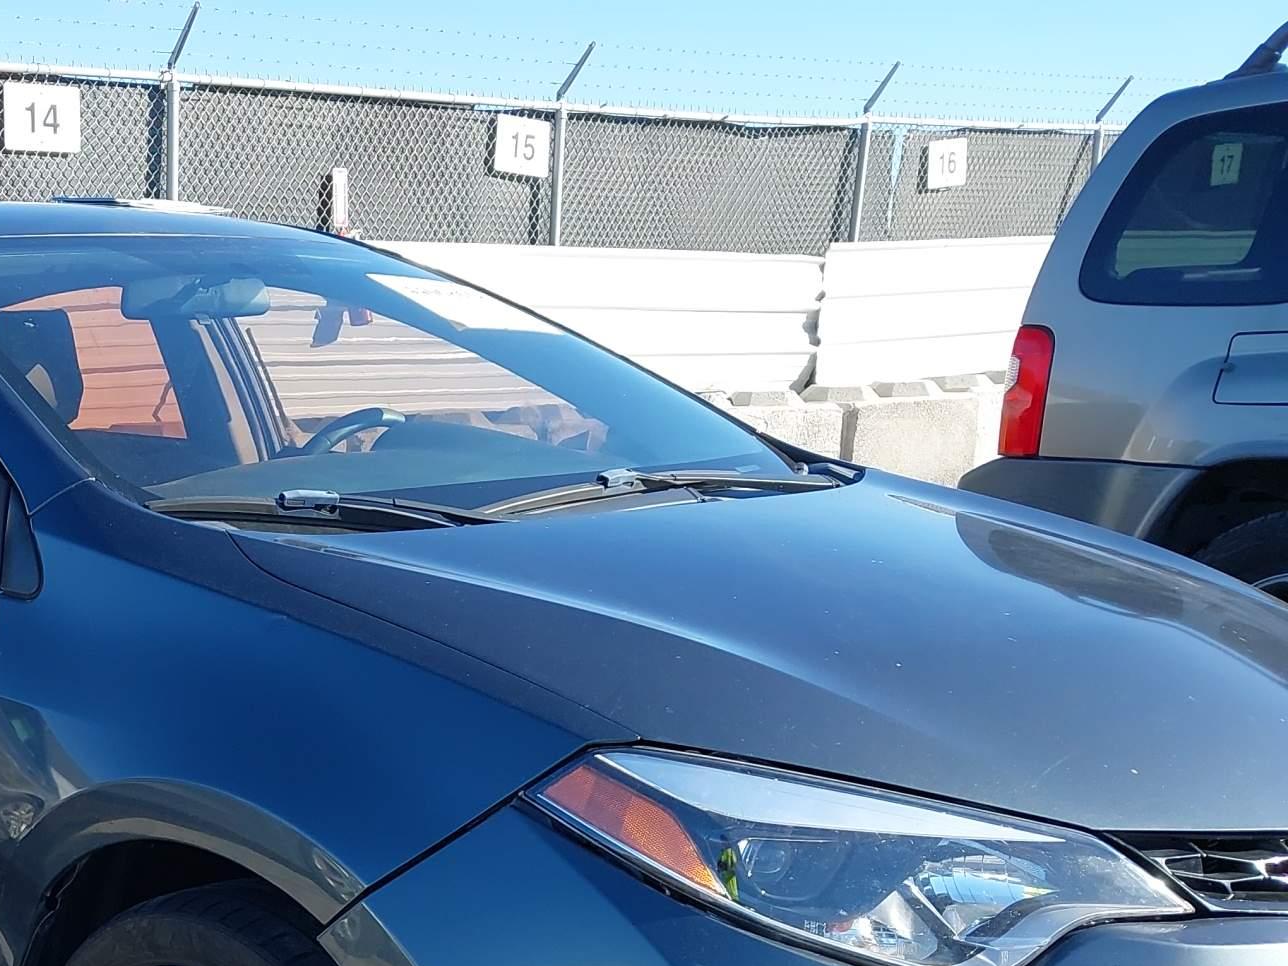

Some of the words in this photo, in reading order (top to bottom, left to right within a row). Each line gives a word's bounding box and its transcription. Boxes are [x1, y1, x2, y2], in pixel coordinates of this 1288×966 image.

[25, 102, 60, 135] 14
[512, 132, 535, 161] 15
[939, 151, 957, 176] 16
[1220, 154, 1234, 176] 17
